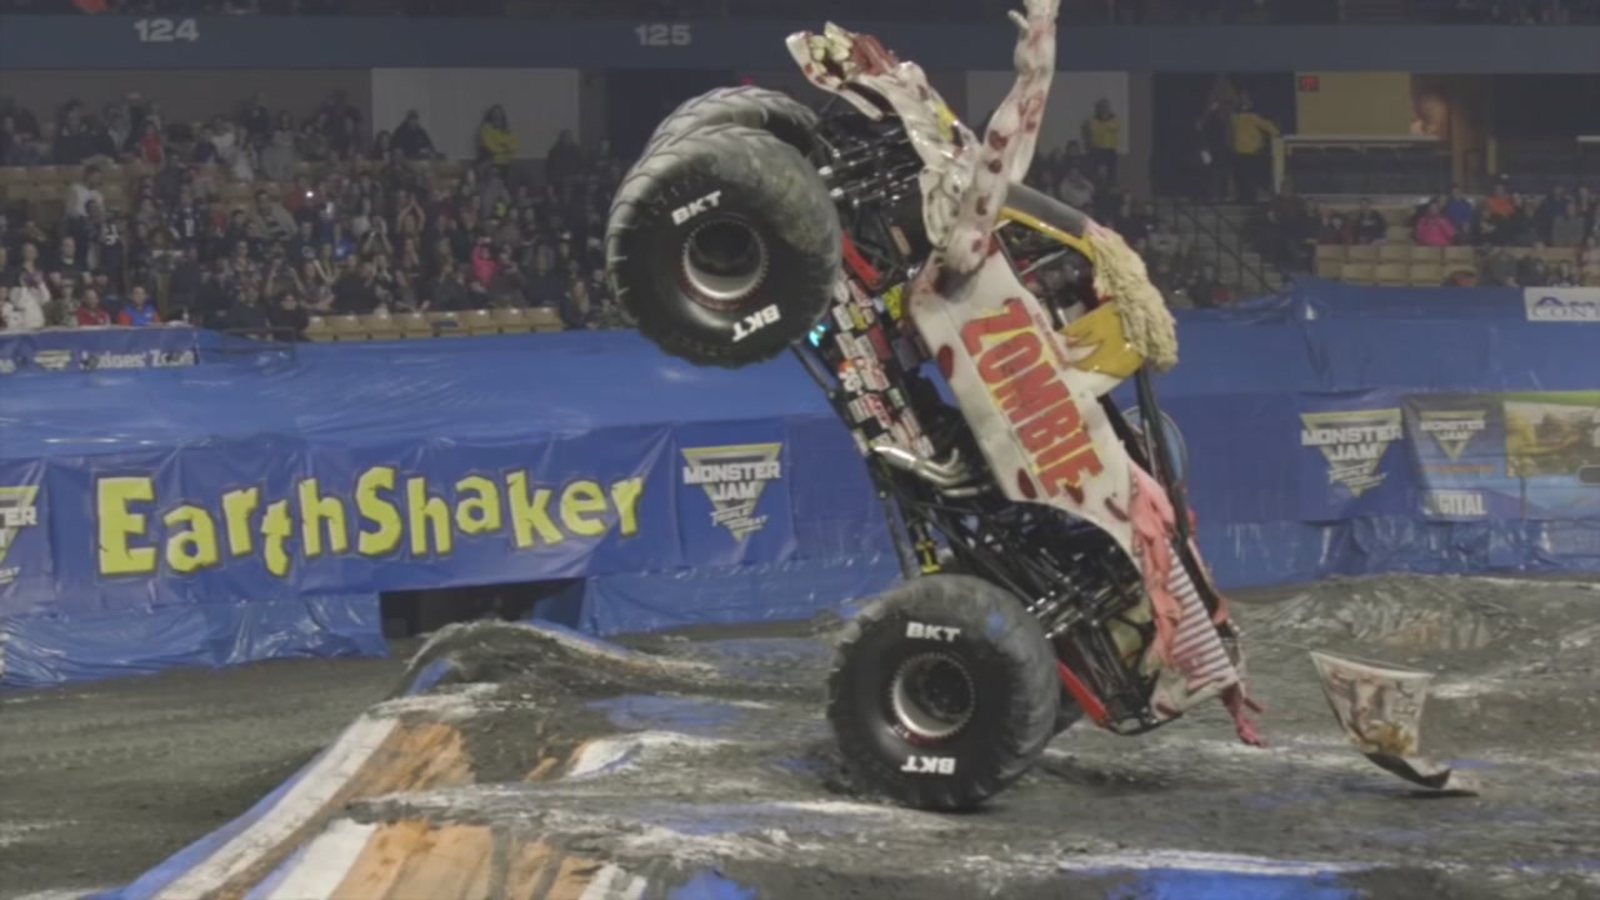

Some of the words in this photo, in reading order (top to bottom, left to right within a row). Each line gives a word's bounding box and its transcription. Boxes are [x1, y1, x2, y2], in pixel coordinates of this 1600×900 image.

[133, 19, 199, 41] 124
[633, 24, 691, 46] 125
[671, 190, 721, 225] BKT
[732, 304, 781, 342] BKT
[960, 297, 1104, 498] ZOMBIE
[1301, 425, 1402, 446] MONSTER
[1331, 442, 1379, 461] JAM
[683, 460, 781, 484] MONSTER
[712, 480, 757, 501] JAM
[1423, 494, 1487, 515] GITAL
[98, 466, 642, 576] EarthShaker
[906, 621, 960, 642] BKT
[901, 755, 956, 775] BKT
